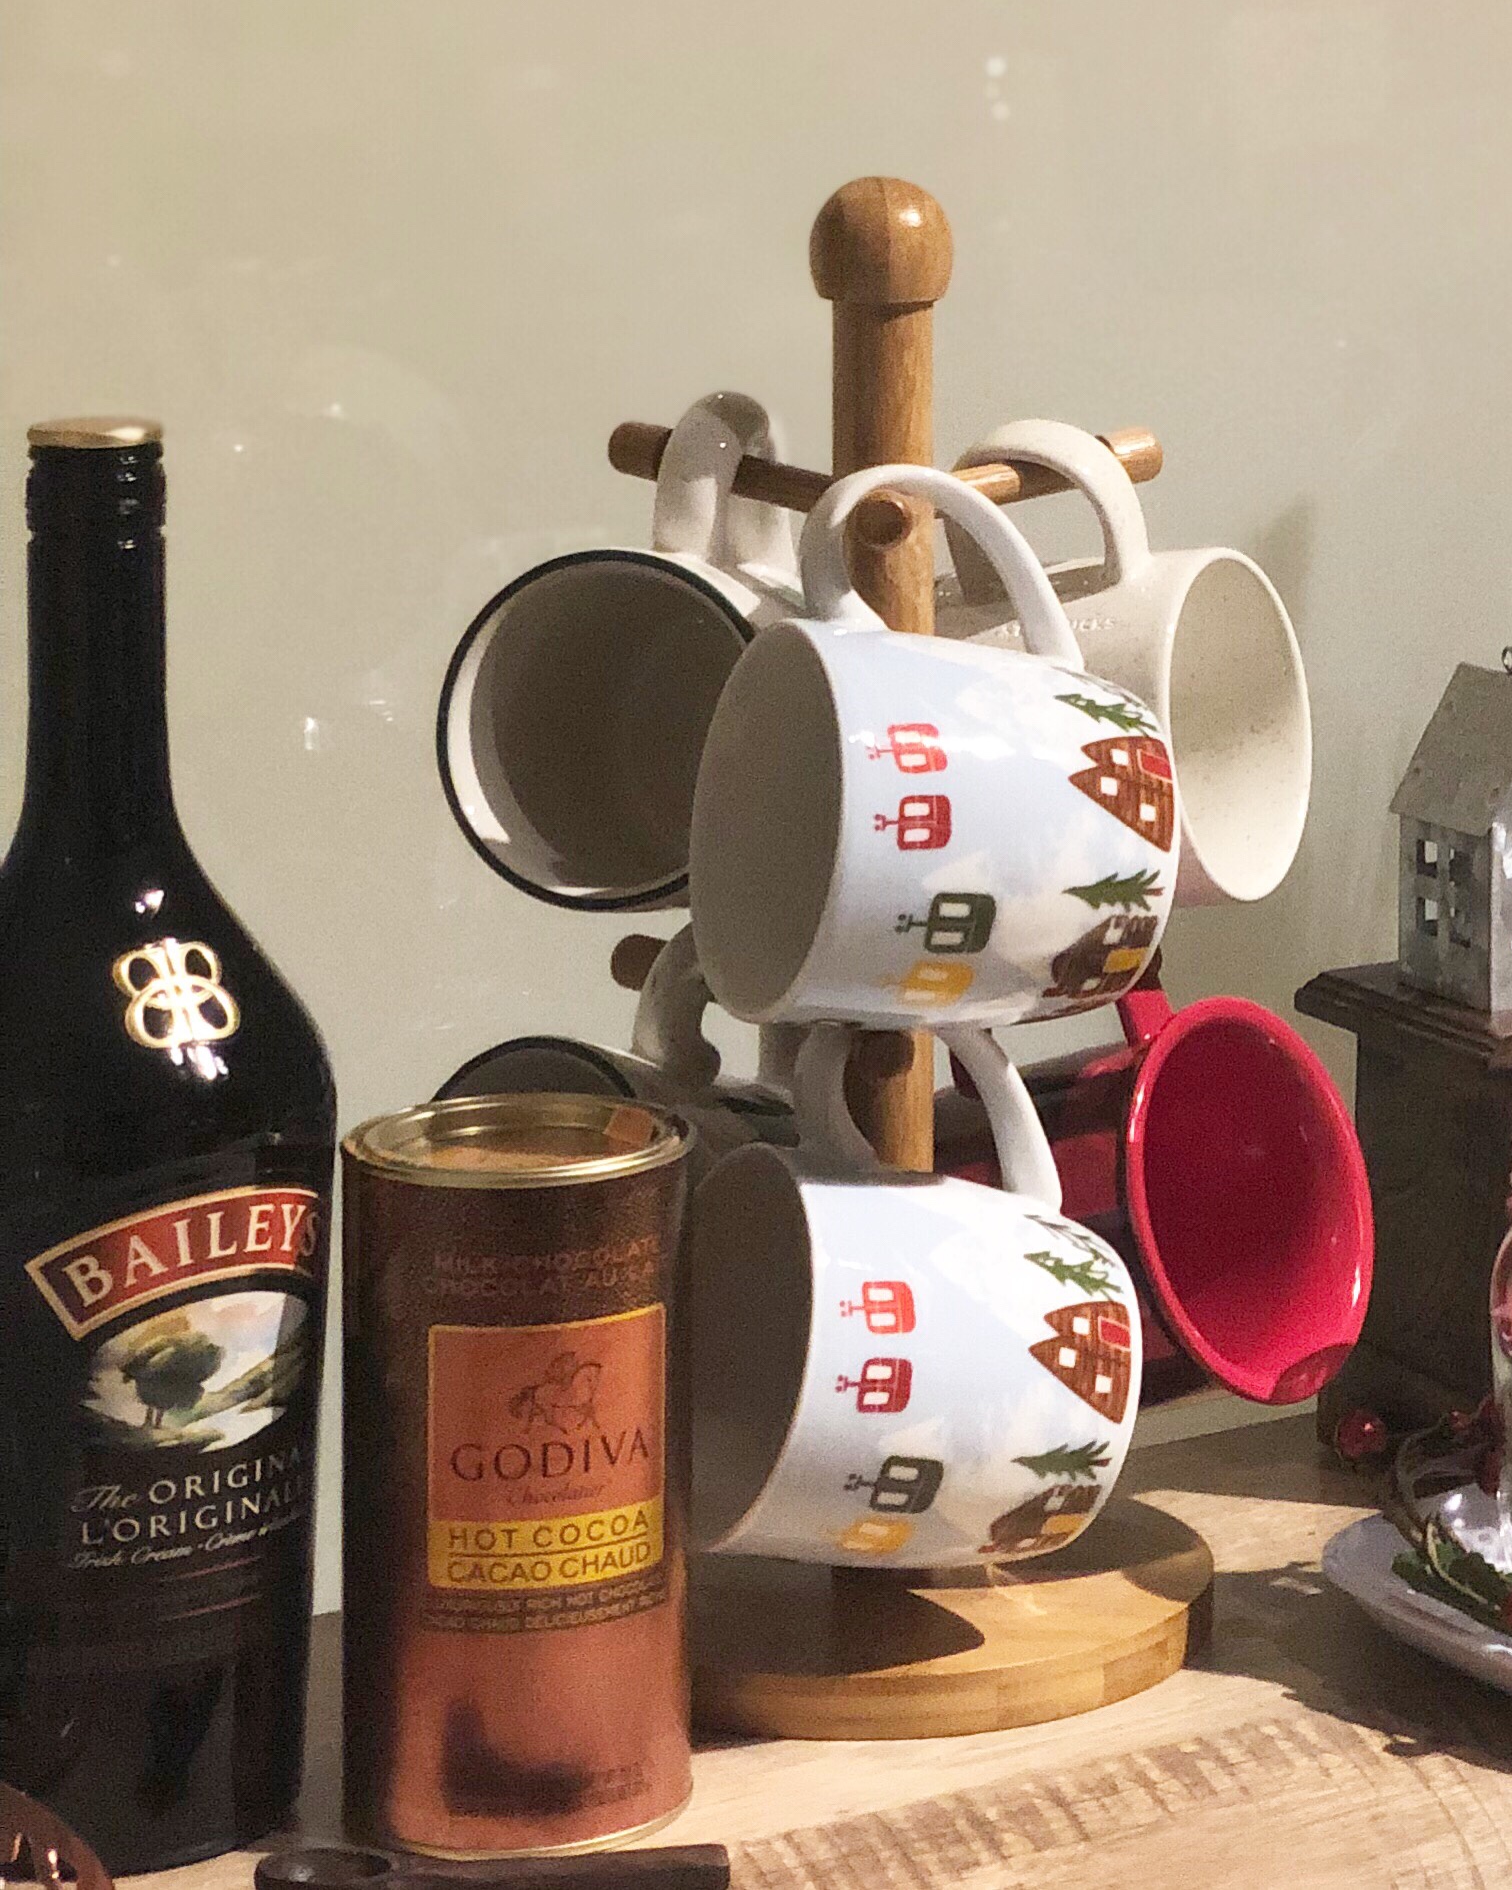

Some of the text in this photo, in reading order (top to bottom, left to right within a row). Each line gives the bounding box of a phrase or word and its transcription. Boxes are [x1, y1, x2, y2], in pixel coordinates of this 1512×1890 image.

[451, 1428, 649, 1481] GODIVA
[71, 1484, 138, 1512] The
[449, 1509, 649, 1551] HOT COCOA
[447, 1541, 651, 1584] CACAO CHAUD
